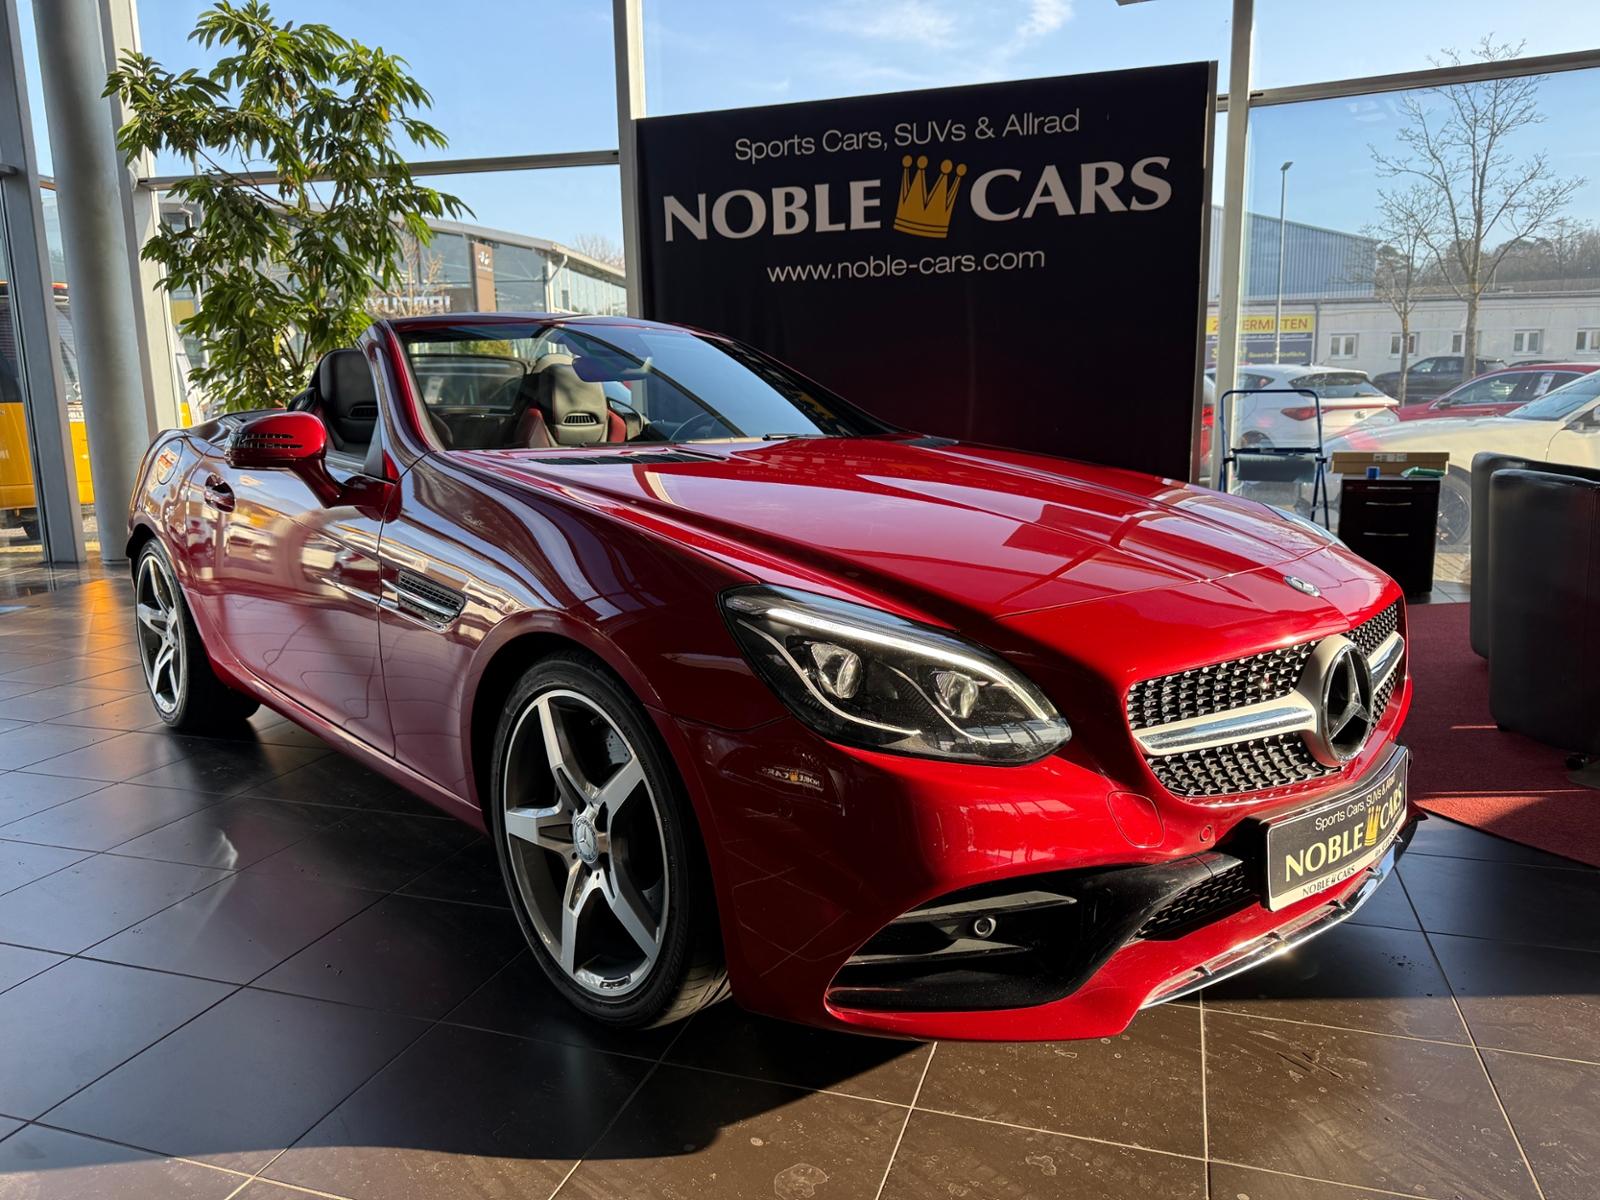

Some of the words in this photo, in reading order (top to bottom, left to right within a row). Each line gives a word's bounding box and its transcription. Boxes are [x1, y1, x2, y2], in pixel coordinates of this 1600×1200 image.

[735, 134, 815, 164] Sports
[822, 129, 888, 152] Cars,
[894, 119, 966, 147] SUVs
[974, 116, 996, 139] &
[1001, 107, 1081, 138] Allrad
[663, 179, 881, 242] NOBLE
[970, 156, 1172, 222] CARS
[767, 248, 1046, 283] www.noble-cars.com
[1285, 822, 1364, 882] NOBLE
[1379, 781, 1403, 830] CARS
[1315, 811, 1345, 831] Sports
[1302, 878, 1331, 897] NOBLE
[1336, 865, 1356, 882] CARS
